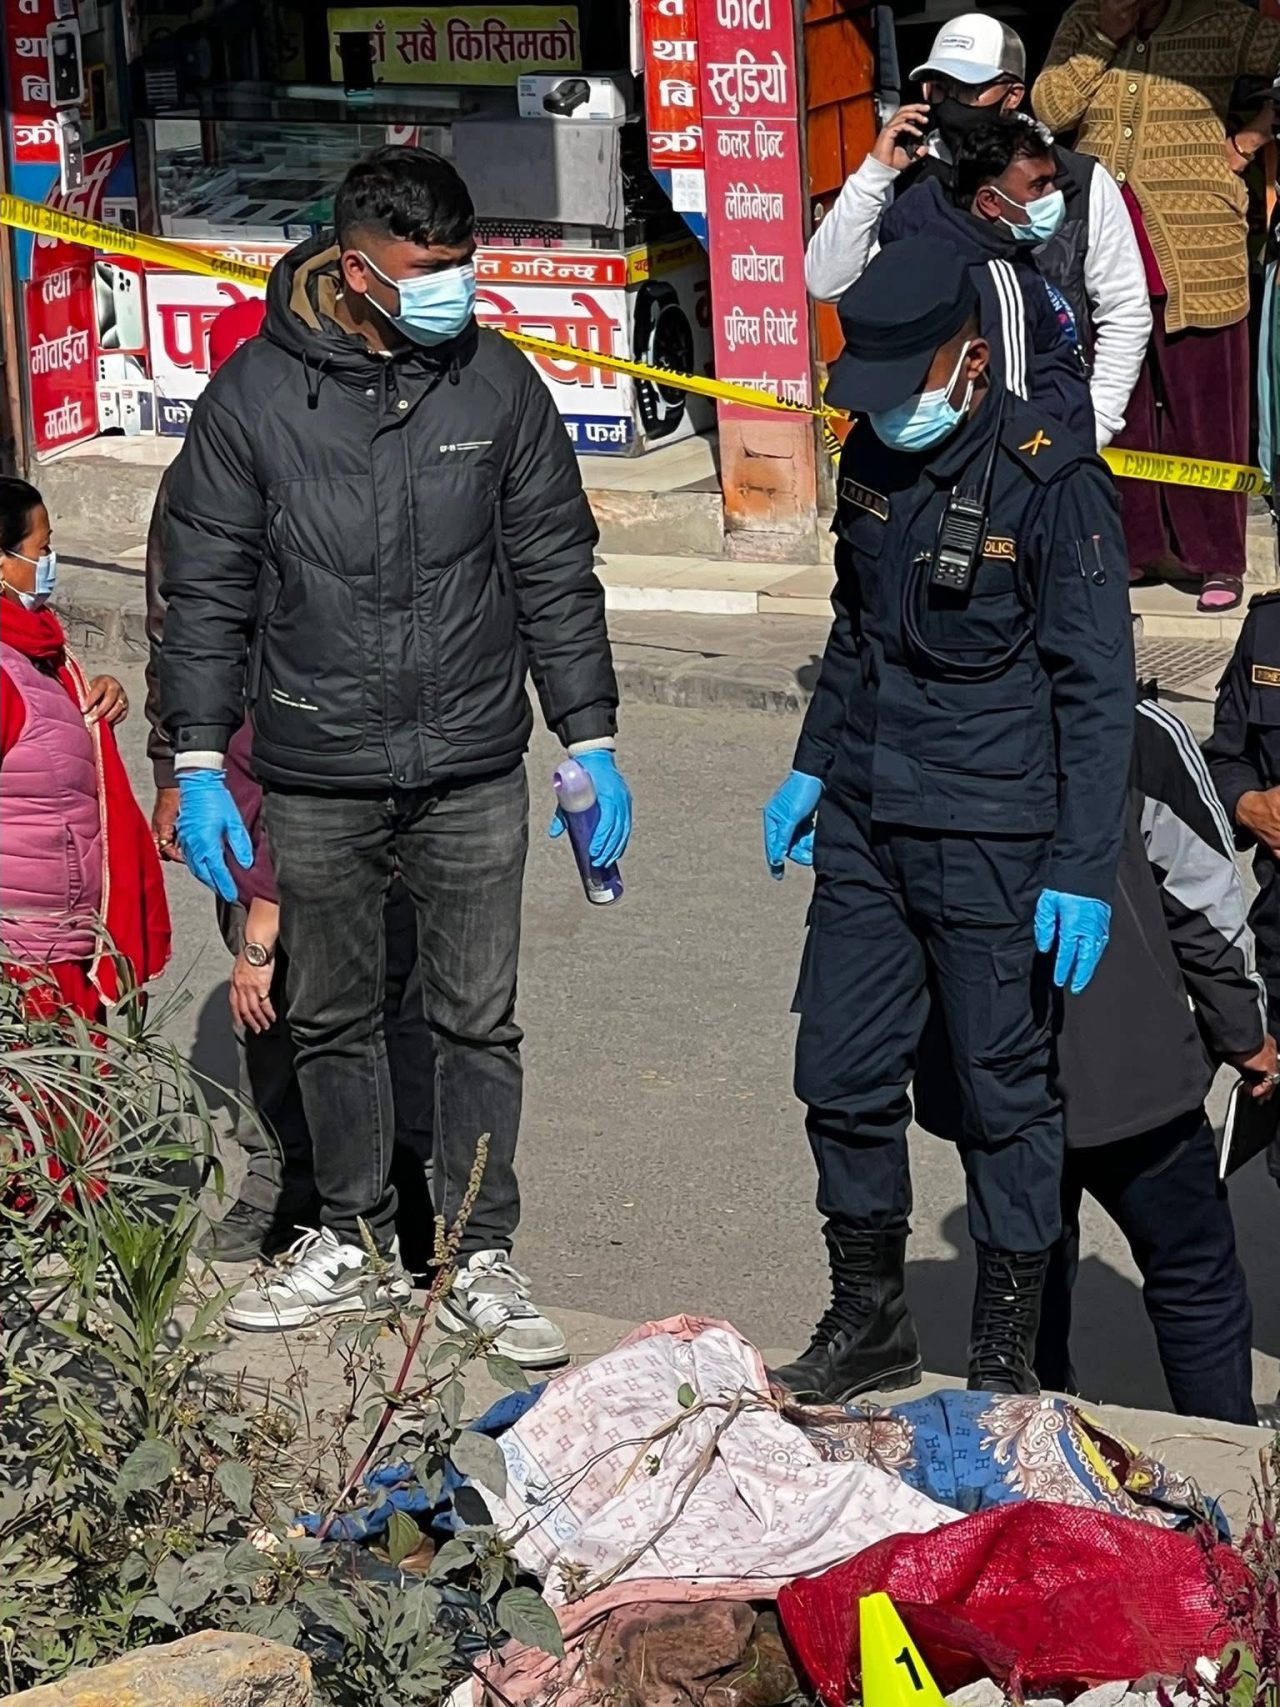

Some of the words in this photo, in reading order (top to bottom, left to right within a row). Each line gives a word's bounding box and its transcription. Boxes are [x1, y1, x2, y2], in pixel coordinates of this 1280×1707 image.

[395, 18, 437, 64] सबै
[446, 17, 577, 64] किसिमको
[707, 48, 788, 115] स्टुडियो
[717, 129, 752, 159] कलर
[754, 120, 785, 161] प्रिन्ट
[724, 182, 784, 223] लेमिनेशन
[511, 258, 599, 281] गरिन्छ
[731, 245, 784, 283] बायोडाटा
[42, 268, 74, 304] तथा
[723, 306, 760, 352] पुलिस
[763, 307, 798, 346] रिपोर्ट
[585, 419, 628, 443] फर्म
[894, 1646, 924, 1691] 1
